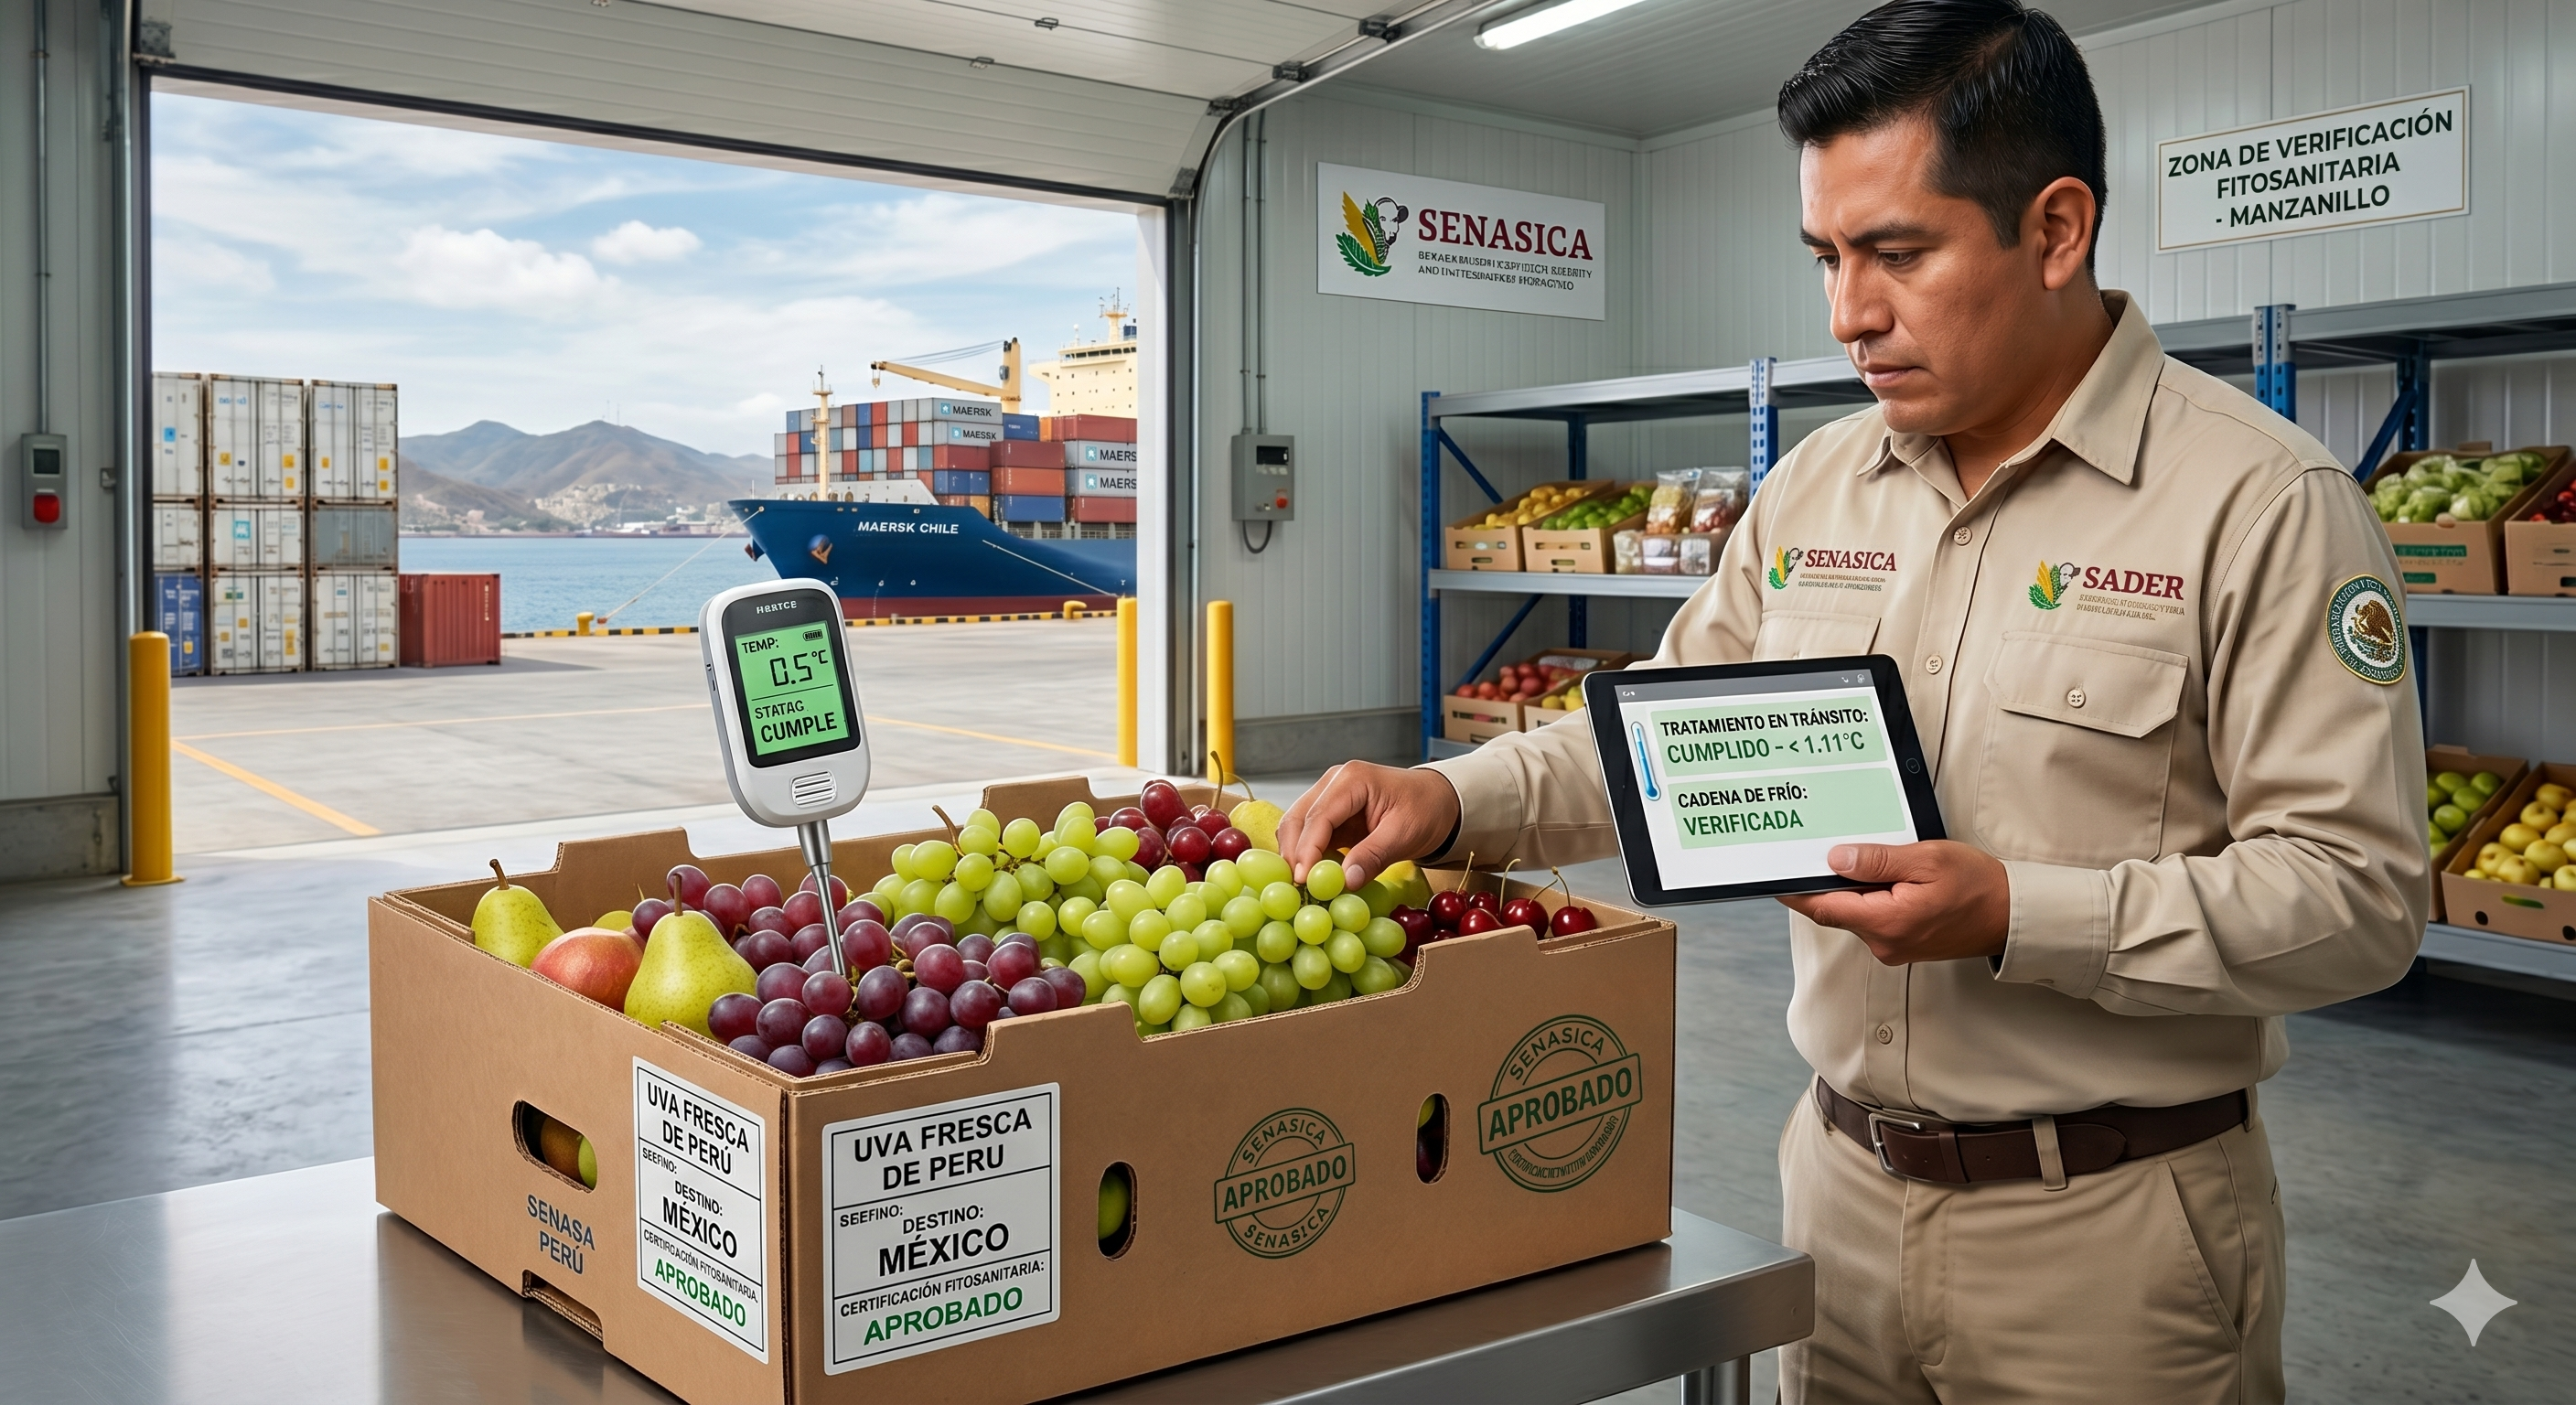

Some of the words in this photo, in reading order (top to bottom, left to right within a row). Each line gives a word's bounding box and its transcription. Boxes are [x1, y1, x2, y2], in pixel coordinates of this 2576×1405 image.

[2168, 148, 2232, 177] ZONA
[2238, 141, 2270, 166] DE
[2276, 107, 2453, 158] VERIFICACIÓN
[2217, 152, 2400, 199] FITOSANITARIA
[2230, 184, 2390, 227] MANZANILLO
[1418, 208, 1594, 261] SENASICA
[952, 405, 993, 417] MAERSK
[857, 520, 916, 533] MAERSK
[919, 522, 960, 534] CHILE
[1805, 549, 1897, 572] SENASICA
[2082, 566, 2184, 600] SADER
[742, 638, 779, 654] TEMP:
[761, 712, 838, 744] CUMPLE
[1660, 714, 1765, 736] TRATAMIENTO
[1768, 713, 1789, 729] EN
[1790, 708, 1869, 726] TRÁNSITO:
[1667, 738, 1770, 764] CUMPLIDO
[1804, 731, 1865, 755] 1.11°C
[1678, 789, 1742, 808] CADENA
[1744, 788, 1766, 803] DE
[1768, 782, 1808, 801] FRÍO:
[1683, 809, 1804, 836] VERIFICADA
[1509, 1026, 1605, 1080] SENASICA
[647, 1081, 680, 1120] UVA
[684, 1100, 749, 1153] FRESCA
[1488, 1067, 1632, 1142] APROBADO
[662, 1120, 684, 1153] DE
[688, 1132, 732, 1175] PERÚ
[854, 1131, 912, 1163] UVA
[921, 1108, 1032, 1150] FRESCA
[1242, 1118, 1326, 1164] SENASICA
[883, 1161, 920, 1191] DE
[930, 1143, 1004, 1182] PERU
[1223, 1155, 1347, 1213] APROBADO
[675, 1180, 723, 1217] DESTINO:
[903, 1205, 983, 1235] DESTINO:
[527, 1194, 596, 1250] SENASA
[663, 1196, 737, 1259] MÉXICO
[1244, 1207, 1329, 1249] SENASICA
[540, 1230, 584, 1274] PERÚ
[879, 1223, 1009, 1277] MÉXICO
[655, 1258, 746, 1328] APROBADO
[841, 1282, 941, 1317] CERTIFICACIÓN
[945, 1260, 1045, 1293] FITOSANITARIA:
[864, 1286, 1023, 1346] APROBADO
